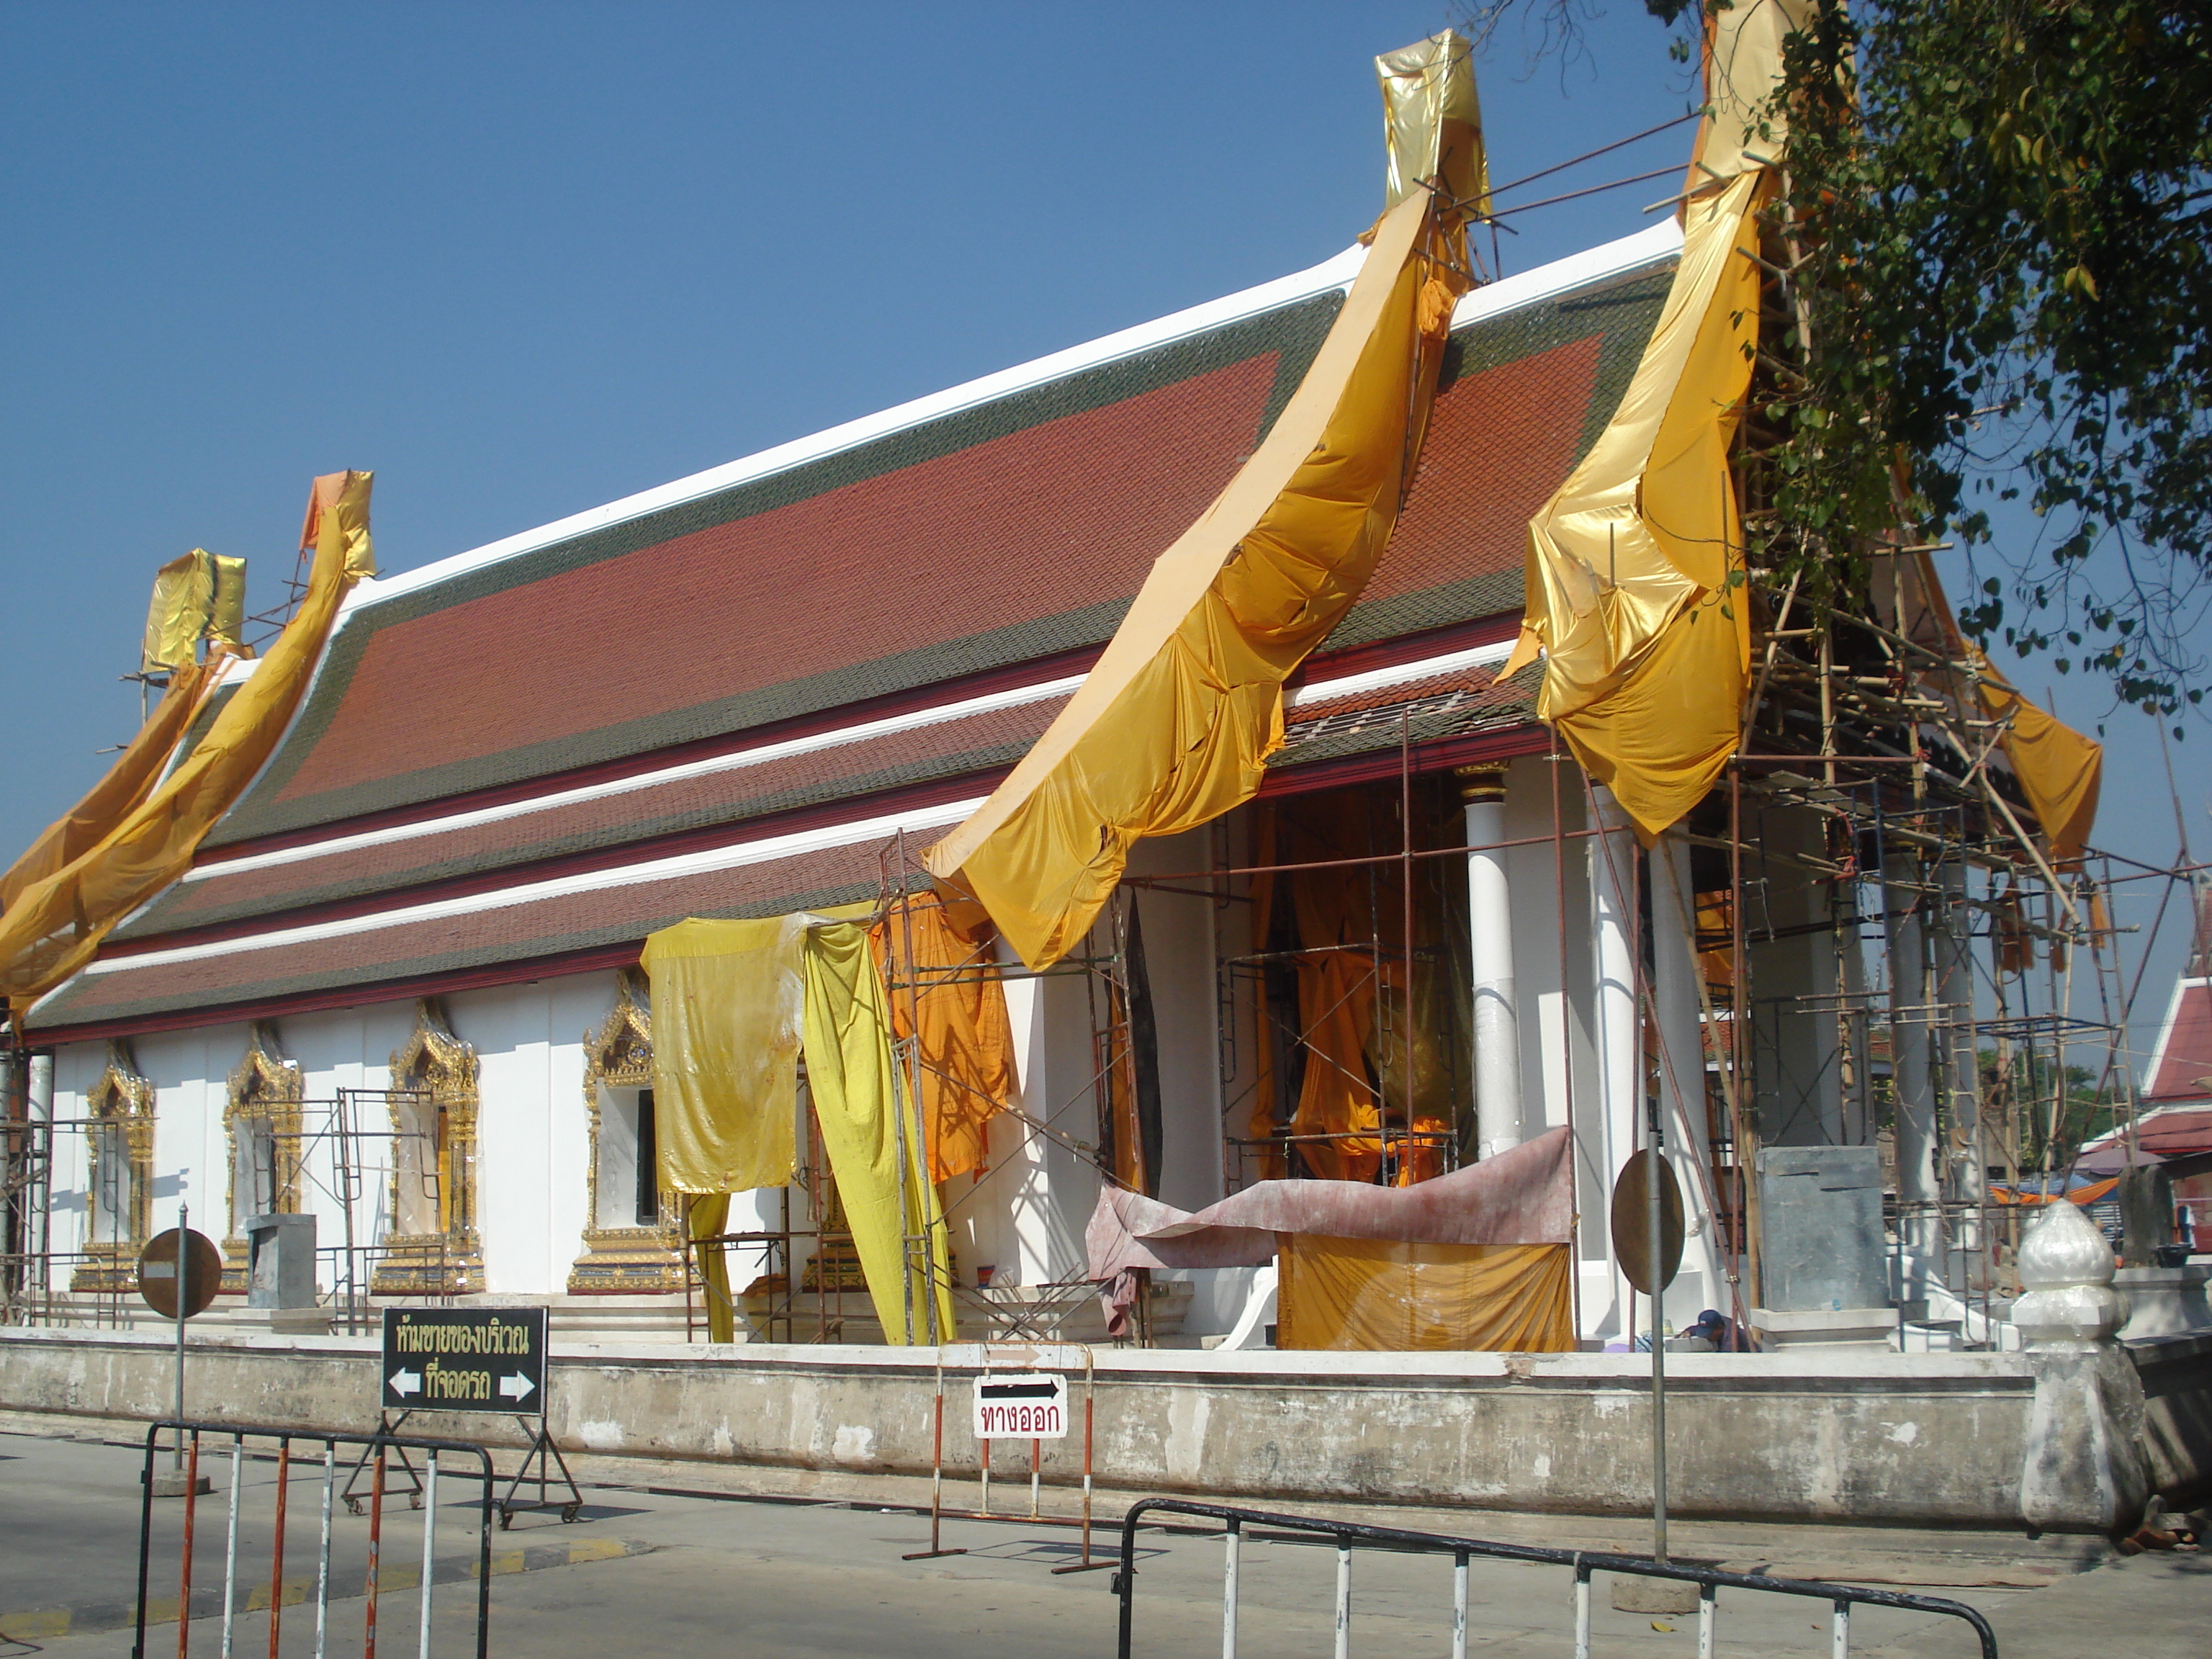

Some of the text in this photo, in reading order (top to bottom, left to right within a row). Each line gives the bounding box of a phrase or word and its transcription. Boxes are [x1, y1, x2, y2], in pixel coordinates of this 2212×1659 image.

[396, 1314, 529, 1354] ห้ามขายของบริเวณ
[426, 1357, 491, 1400] ที่จอดรถ
[981, 1406, 1059, 1431] ทางออก
